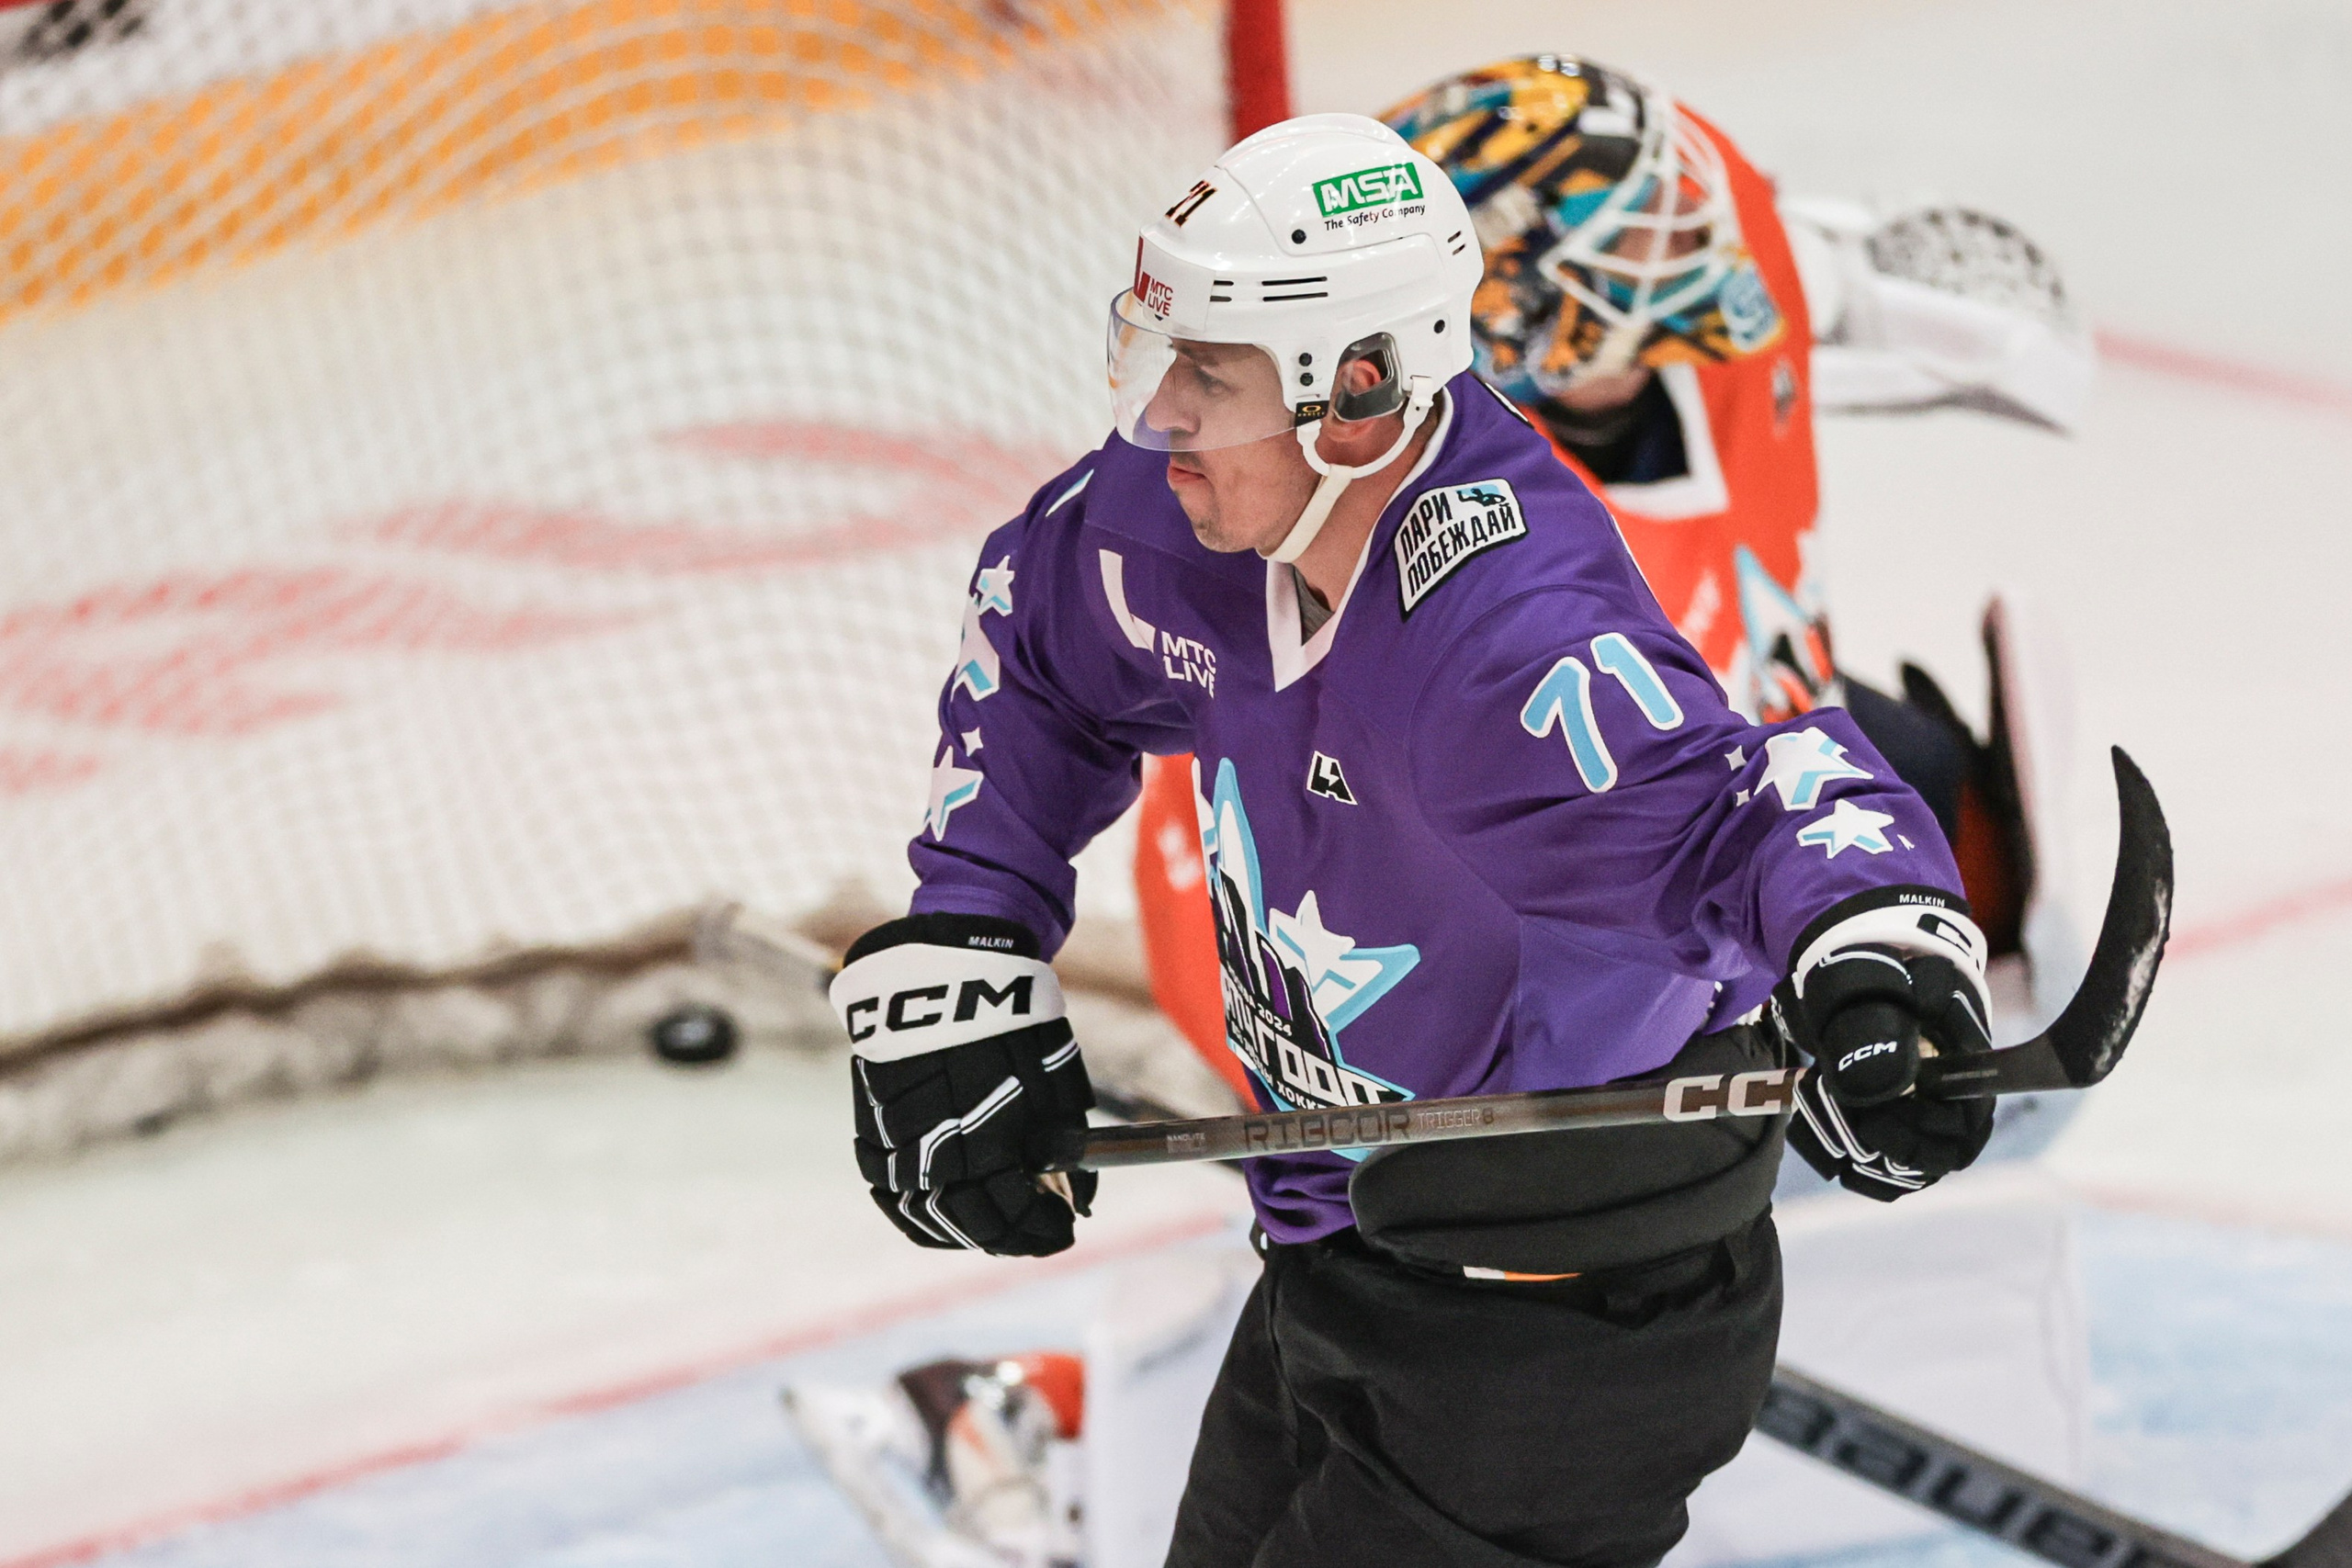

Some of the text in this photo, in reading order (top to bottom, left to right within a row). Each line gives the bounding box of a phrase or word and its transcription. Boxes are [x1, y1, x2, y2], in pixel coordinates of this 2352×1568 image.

[1319, 166, 1419, 213] MSA
[1324, 219, 1344, 231] The
[1347, 211, 1379, 227] Safety
[1148, 295, 1171, 317] LIVE
[1400, 491, 1453, 566] ПАРИ
[1407, 502, 1517, 598] ПОБЕЖДАЙ
[1520, 631, 1684, 794] 71
[1899, 894, 1945, 908] MALKIN
[967, 936, 1014, 949] MALKIN
[846, 976, 1035, 1043] CCM
[1257, 1002, 1293, 1037] 2024
[1838, 1041, 1898, 1072] CCM
[1243, 1109, 1410, 1151] RIBCOR
[1416, 1109, 1480, 1130] TRIGGER
[1663, 1067, 1808, 1122] CC
